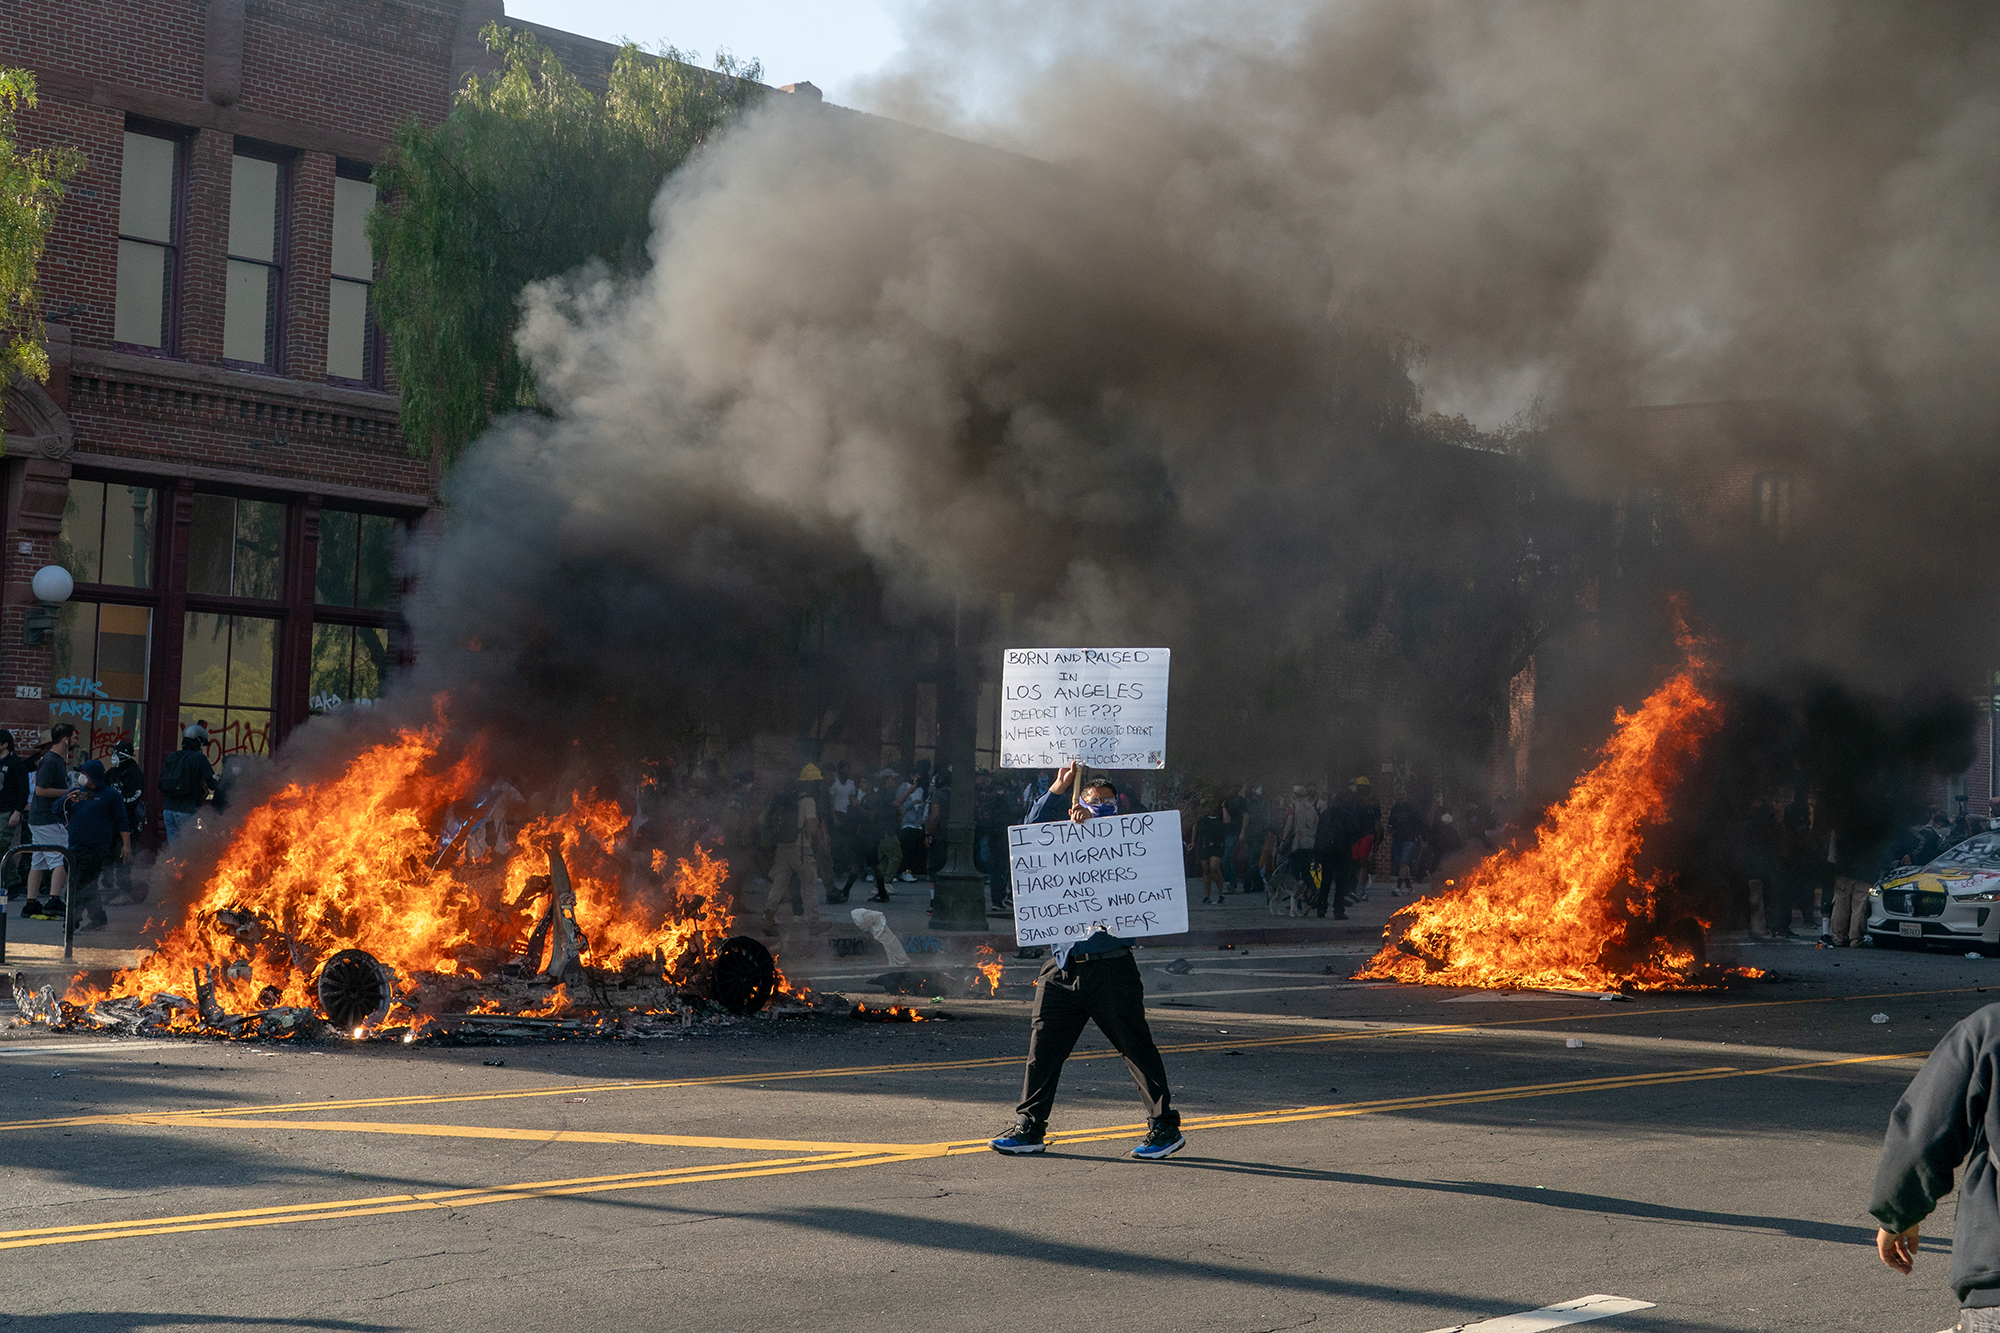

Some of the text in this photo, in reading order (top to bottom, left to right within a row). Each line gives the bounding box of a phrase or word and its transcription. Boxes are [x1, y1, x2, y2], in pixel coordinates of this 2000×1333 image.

[1007, 650, 1149, 665] BORN AND RAISED
[1058, 672, 1078, 681] IN
[20, 688, 38, 697] 415
[1006, 683, 1143, 700] LOS ANGELES
[1010, 706, 1059, 720] DEPORT
[1004, 725, 1153, 741] WHERE YOU GOING TO DEPORT
[1050, 740, 1067, 750] ME
[1003, 753, 1035, 766] BACK
[1058, 752, 1081, 763] THE
[1011, 814, 1154, 847] I STAND FOR
[1015, 842, 1146, 869] ALL MIGRANTS
[1016, 866, 1138, 895] HARD WORKERS
[1062, 887, 1095, 898] AND
[1019, 888, 1172, 921] STUDENTS WHO CANT
[1020, 925, 1059, 942] STAND
[1064, 922, 1087, 936] OUT
[1115, 911, 1159, 931] FEAR
